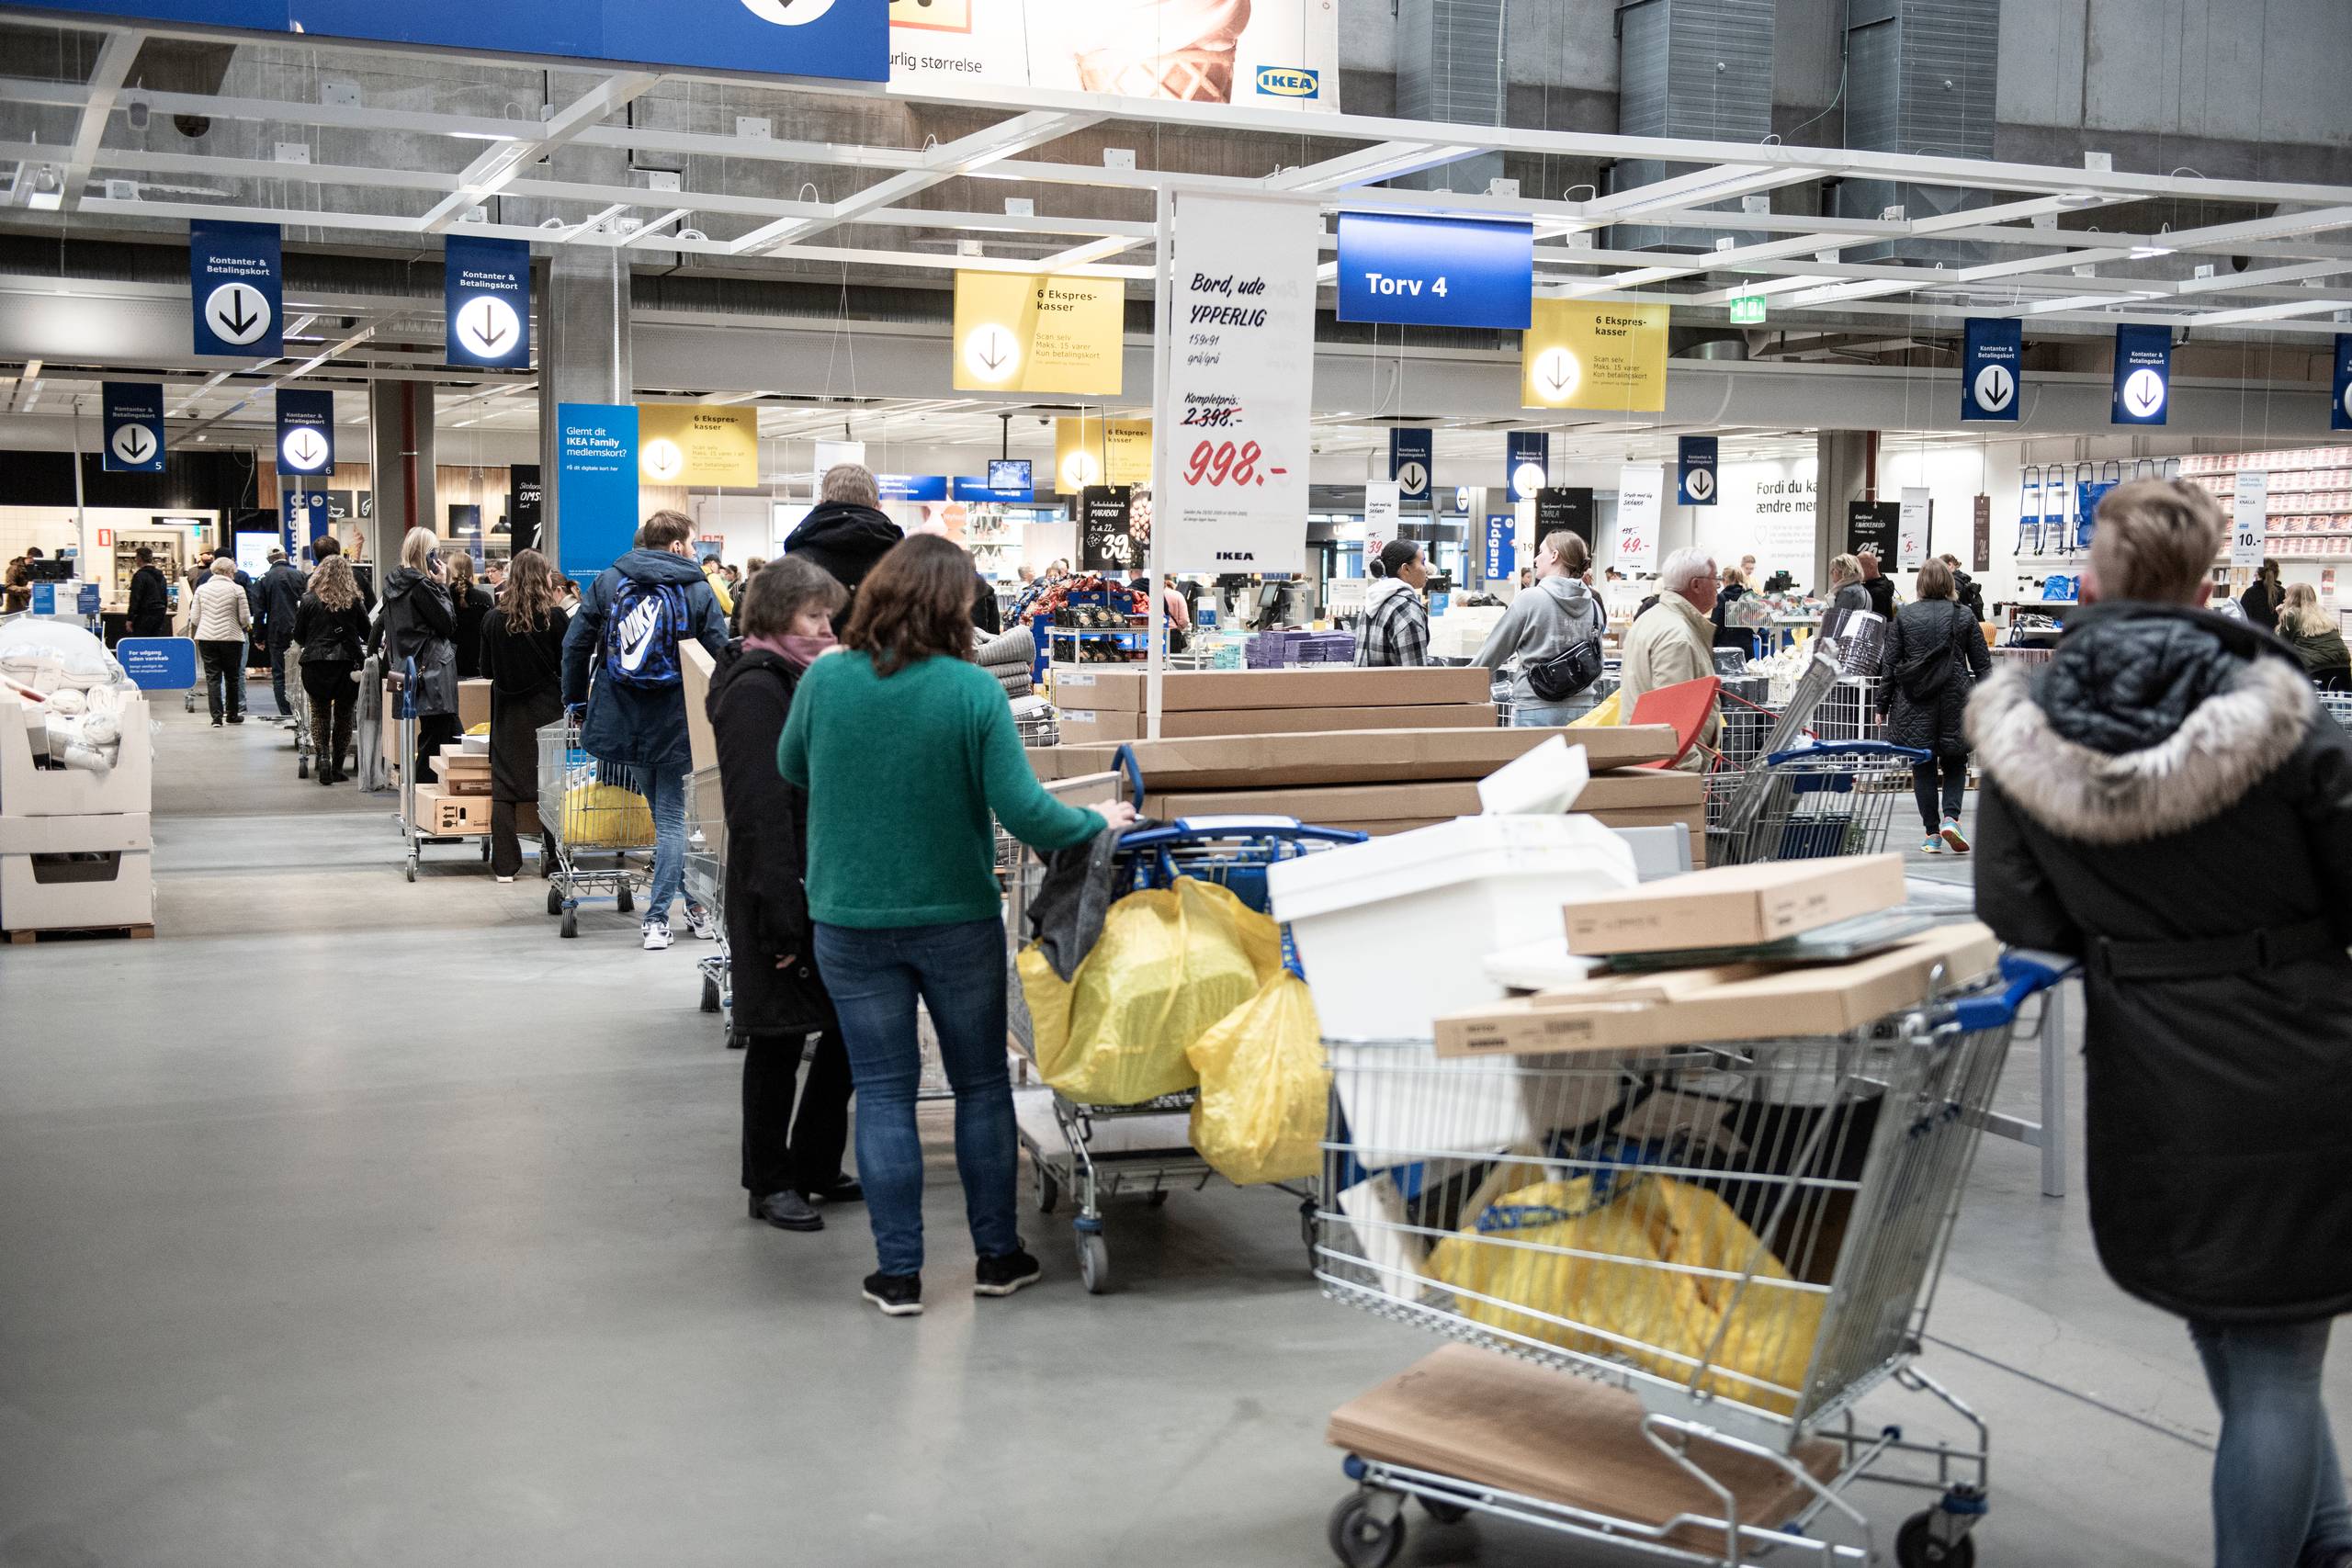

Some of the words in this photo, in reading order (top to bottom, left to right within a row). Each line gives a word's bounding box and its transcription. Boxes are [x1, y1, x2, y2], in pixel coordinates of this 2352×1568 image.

[921, 56, 982, 73] størrelse
[1262, 74, 1313, 89] IKEA
[209, 256, 256, 265] Kontanter
[207, 265, 270, 276] Betalingskort
[462, 270, 506, 280] Kontanter
[459, 279, 518, 290] Betalingskort
[1190, 273, 1233, 298] Bord,
[1238, 276, 1266, 295] ude
[1365, 273, 1423, 296] Torv
[1431, 276, 1448, 298] 4
[1037, 288, 1045, 299] 6
[1048, 289, 1099, 301] Ekspres-
[1036, 301, 1075, 311] kasser
[1190, 304, 1267, 327] YPPERLIG
[1595, 315, 1602, 324] 6
[1605, 316, 1647, 327] Ekspres-
[1595, 326, 1627, 336] kasser
[1189, 333, 1220, 345] 159x91
[1052, 350, 1101, 360] betalingskort
[1187, 351, 1221, 367] grå/grå
[1607, 371, 1647, 380] betalingskort
[1184, 392, 1240, 407] Kompletpris:
[702, 415, 739, 423] Ekspres-
[1182, 407, 1243, 427] 2.398.-
[566, 426, 593, 436] Glemt
[594, 427, 606, 436] dit
[694, 423, 721, 431] kasser
[566, 437, 588, 446] IKEA
[590, 437, 620, 449] Family
[566, 448, 628, 457] medlemskort?
[155, 461, 163, 470] 5
[1183, 440, 1287, 487] 998.-
[325, 467, 332, 475] 6
[1757, 479, 1784, 494] Fordi
[1788, 479, 1802, 493] du
[1756, 499, 1792, 513] ændre
[1090, 509, 1119, 517] MARABOU
[1623, 537, 1650, 553] 49.-
[2239, 534, 2261, 547] 10.-
[1487, 517, 1502, 578] Udgang
[1216, 551, 1254, 560] IKEA
[617, 595, 657, 650] NIKE
